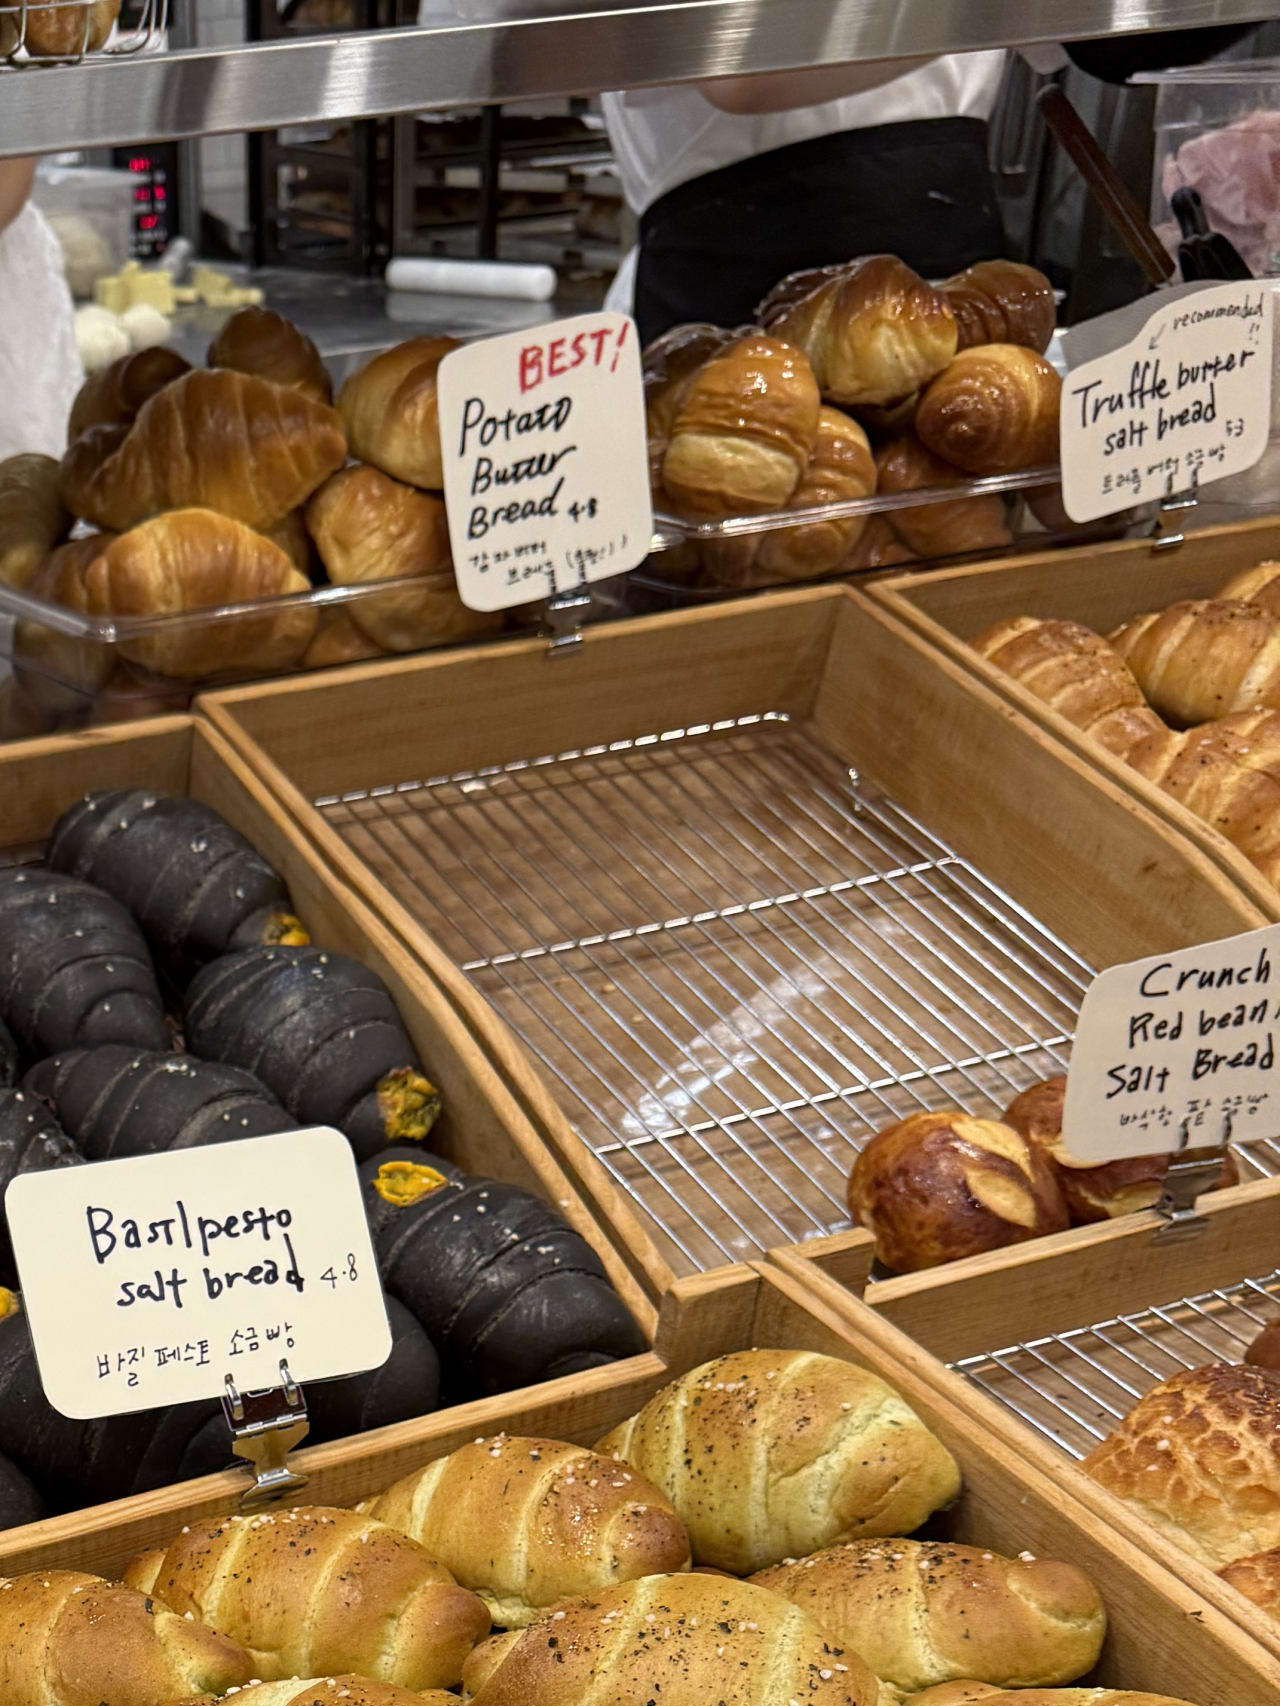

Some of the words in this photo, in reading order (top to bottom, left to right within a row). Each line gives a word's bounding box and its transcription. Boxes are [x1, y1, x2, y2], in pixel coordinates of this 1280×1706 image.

[1173, 293, 1265, 331] recommended
[519, 321, 630, 394] BEST!
[1072, 358, 1170, 429] Truffle
[1177, 350, 1255, 391] butter
[1103, 420, 1148, 456] salt
[1157, 382, 1217, 441] bread
[460, 397, 573, 458] Potato
[471, 446, 578, 496] Butter
[468, 477, 565, 541] Bread
[1139, 947, 1271, 998] Crunch
[1128, 1011, 1183, 1049] Red
[1198, 998, 1269, 1037] bean
[1105, 1063, 1170, 1100] Salt
[1192, 1032, 1274, 1081] Bread
[197, 1206, 292, 1257] pesto
[117, 1269, 188, 1309] salt
[203, 1233, 305, 1300] bread
[228, 1321, 296, 1357] 소금빵
